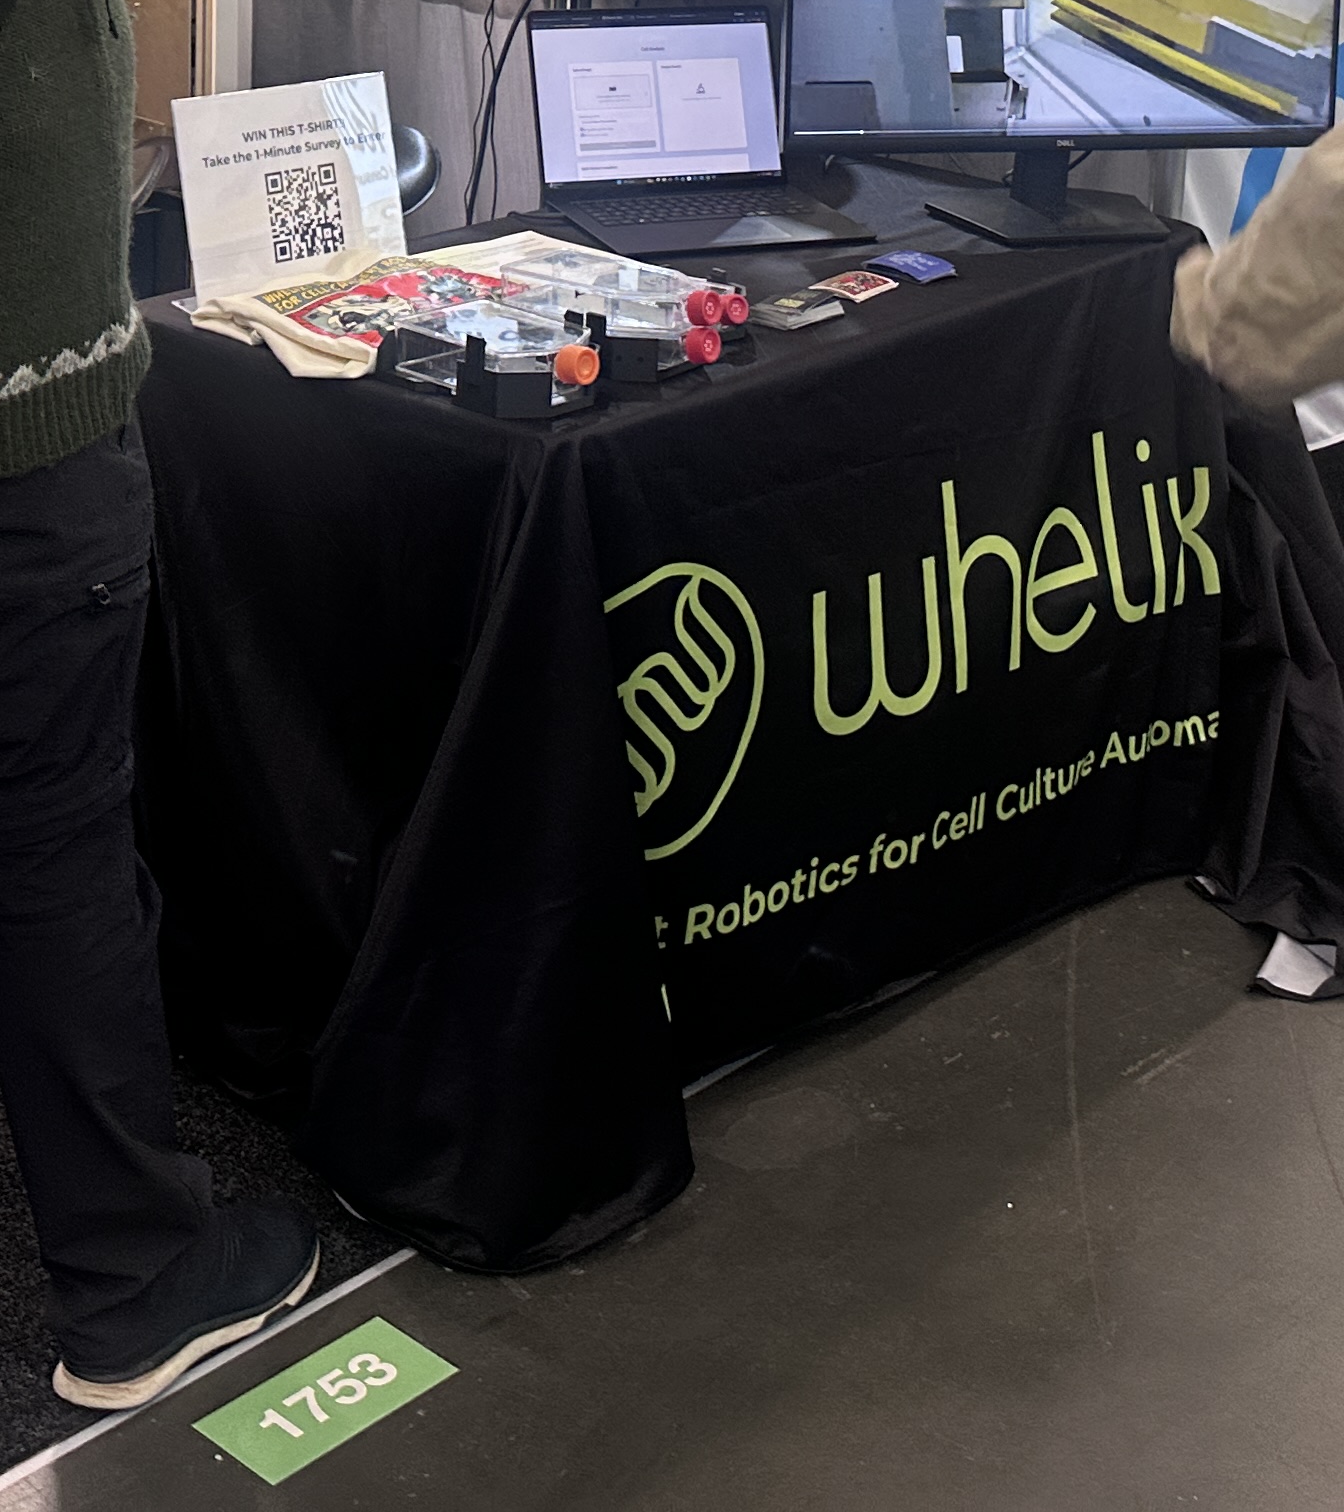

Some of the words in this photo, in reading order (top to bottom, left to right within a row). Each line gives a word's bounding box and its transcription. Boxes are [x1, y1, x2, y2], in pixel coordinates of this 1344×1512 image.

[202, 155, 231, 169] Take
[233, 150, 252, 165] the
[254, 143, 303, 161] 1-Minute
[305, 138, 342, 153] Survey
[343, 134, 355, 146] to
[241, 129, 267, 143] WIN
[269, 124, 296, 139] THIS
[273, 296, 304, 313] FOR
[812, 430, 1222, 737] whelix
[684, 852, 860, 945] Robotics
[869, 831, 928, 876] for
[931, 792, 986, 851] Cell
[997, 750, 1096, 823] Culture
[258, 1351, 398, 1438] 1753
